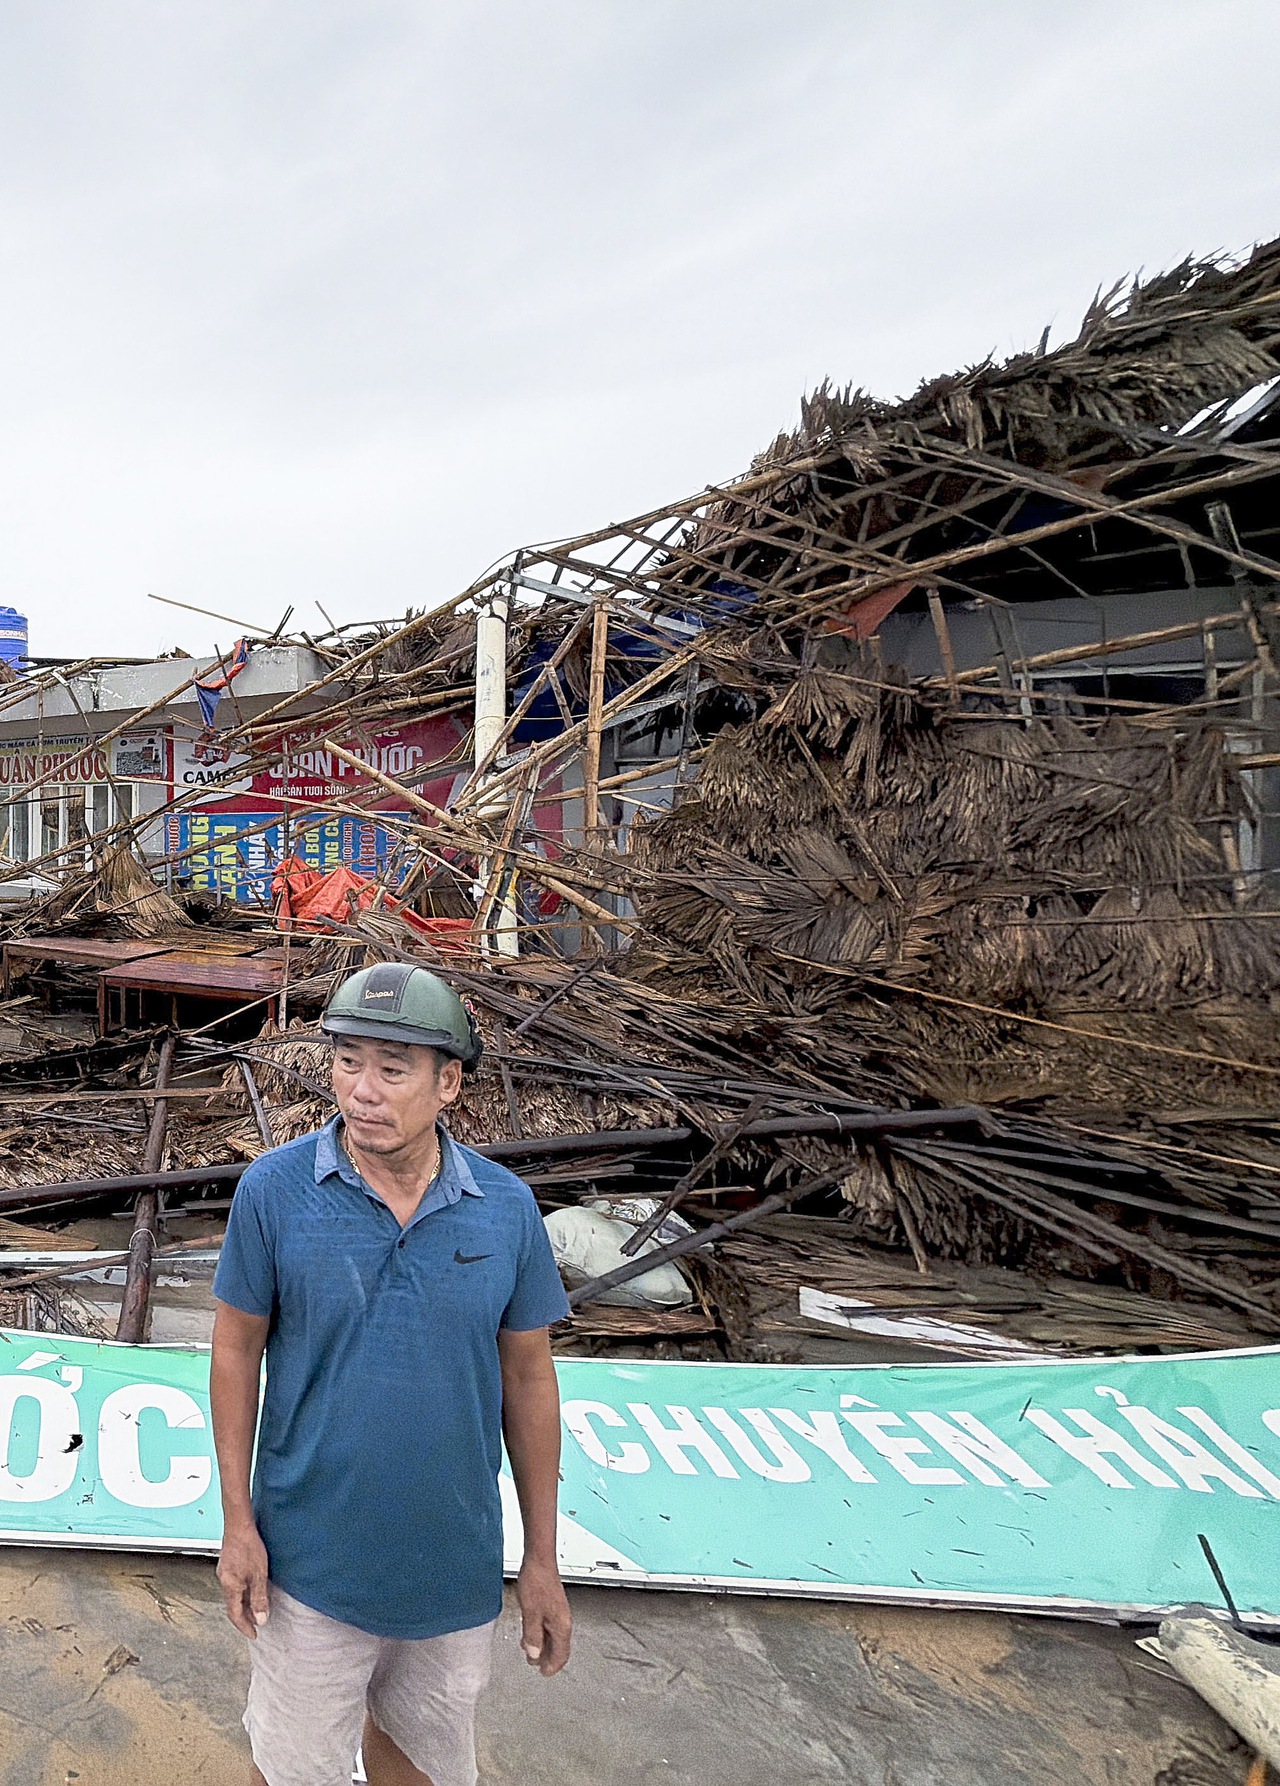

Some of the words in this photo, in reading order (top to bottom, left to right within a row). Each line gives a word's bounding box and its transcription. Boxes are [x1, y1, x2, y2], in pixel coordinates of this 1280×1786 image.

[182, 816, 210, 892] HÒNG
[243, 820, 266, 874] NHẢ
[561, 1393, 1053, 1489] CHUYÊN
[1028, 1385, 1280, 1502] HẢI
